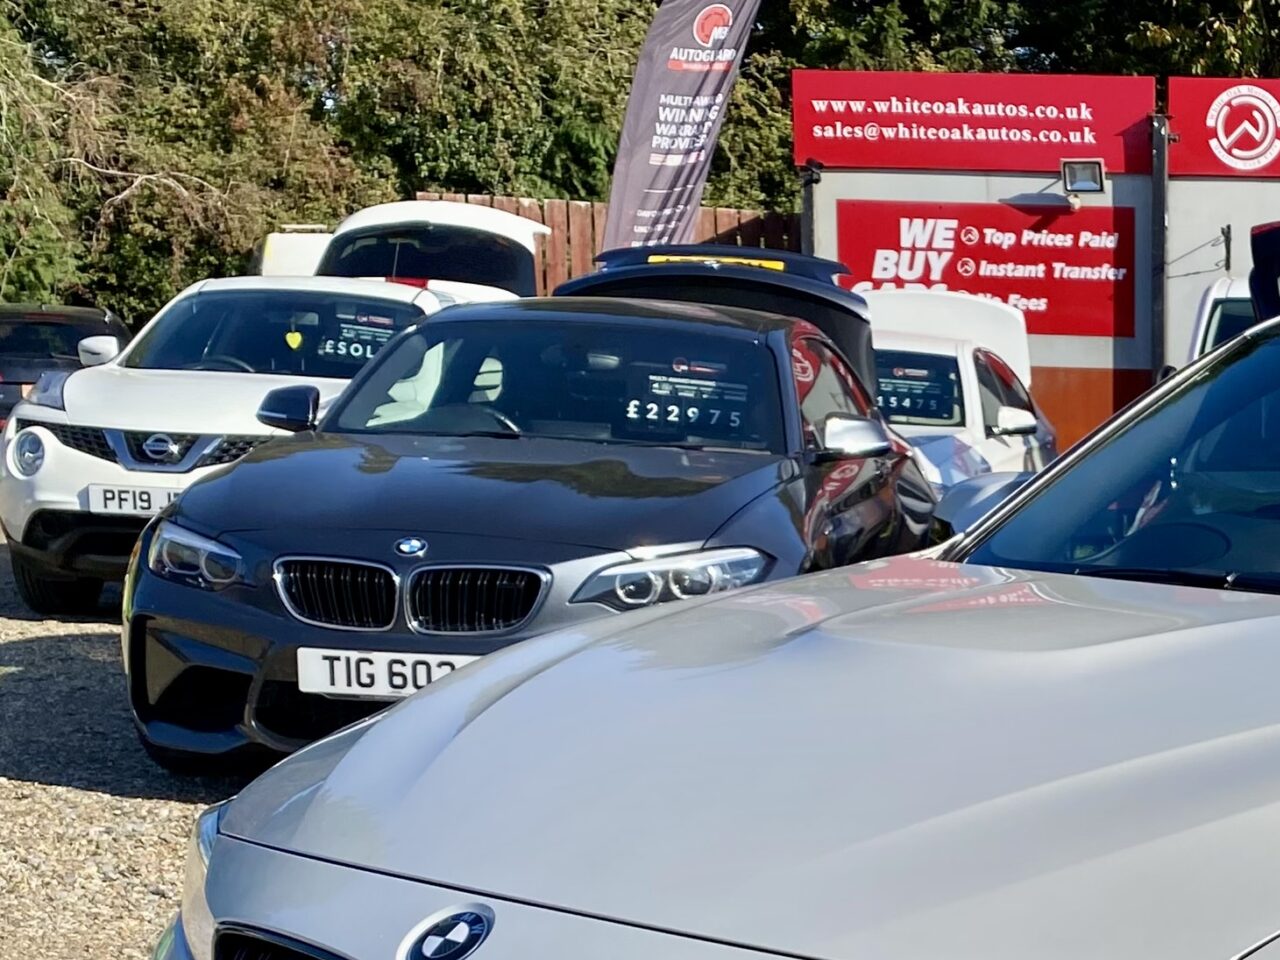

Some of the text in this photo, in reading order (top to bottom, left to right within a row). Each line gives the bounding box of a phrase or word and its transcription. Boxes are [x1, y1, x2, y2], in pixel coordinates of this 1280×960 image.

[811, 97, 1094, 121] www.whiteoakautos.co.uk
[812, 121, 1097, 145] sales@whiteoakautos.co.uk
[899, 217, 959, 249] WE
[983, 228, 1119, 249] Top Prices Paid
[871, 249, 953, 280] BUY
[978, 260, 1127, 281] Instant Transfer
[1008, 293, 1049, 311] Fees
[626, 399, 742, 428] £22975
[103, 489, 152, 510] PF19
[321, 655, 376, 688] TIG
